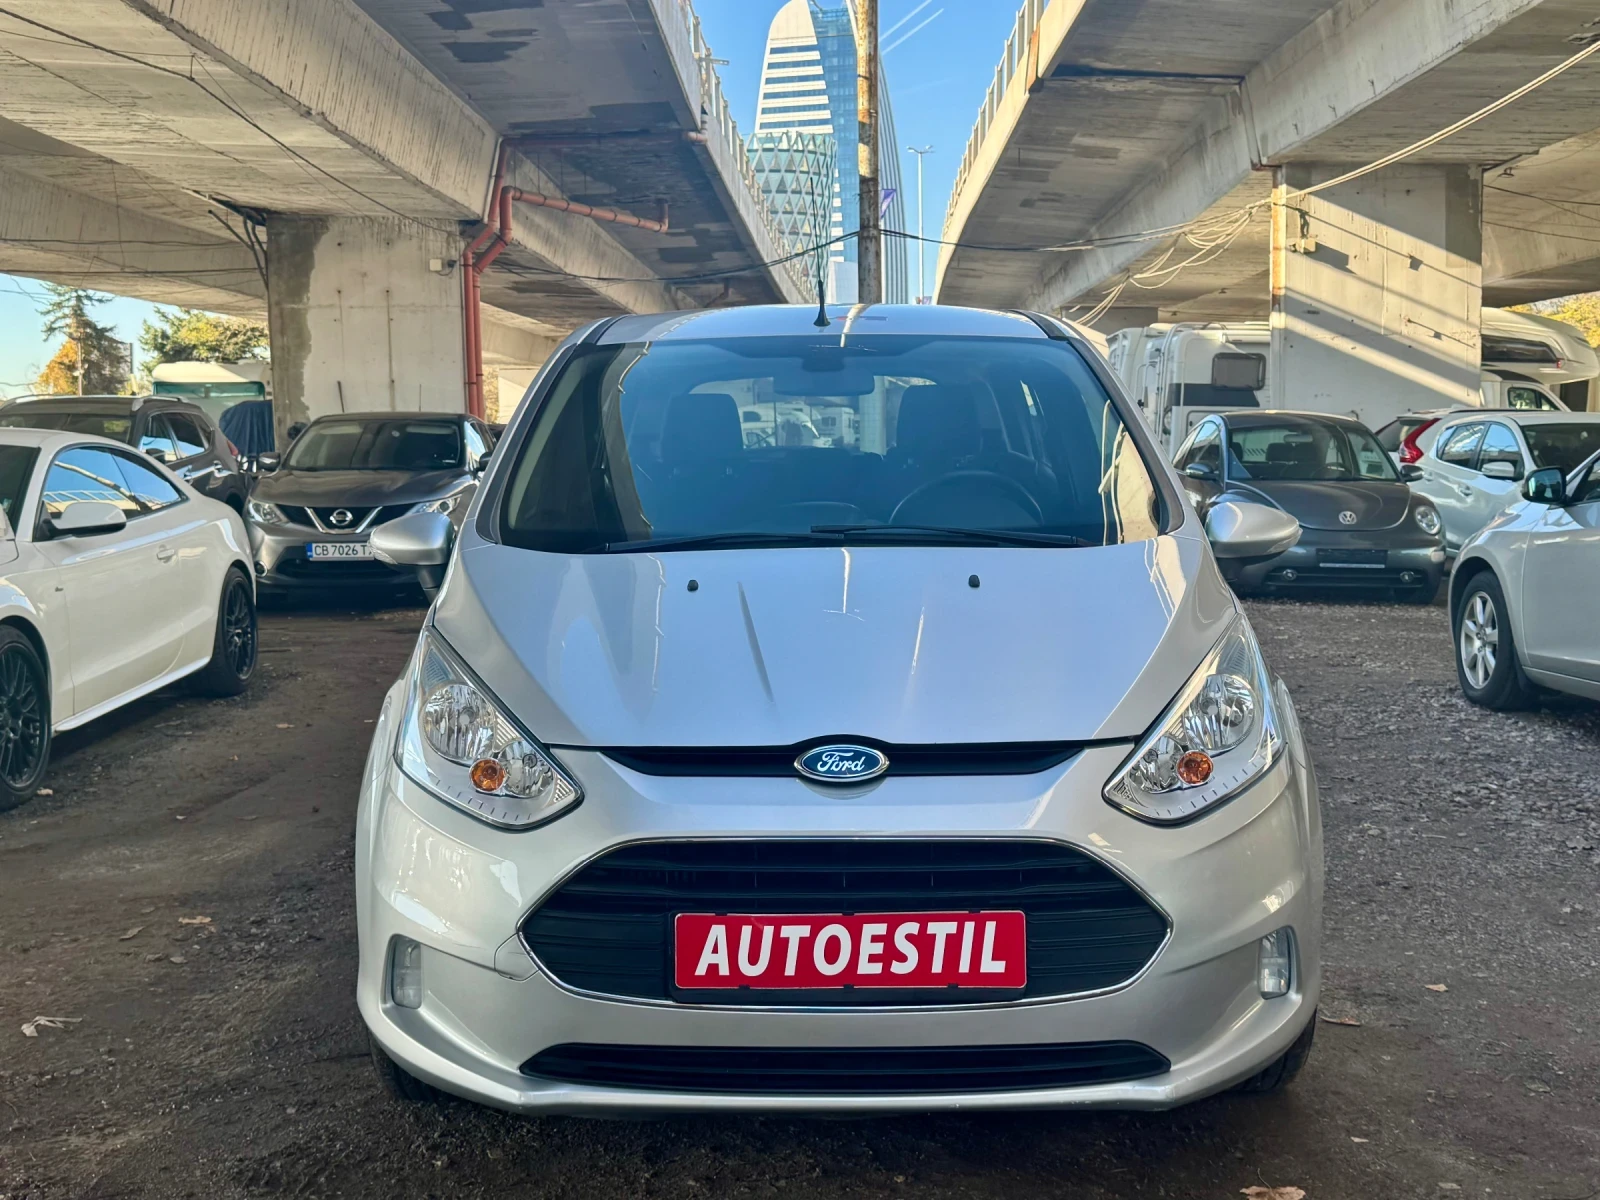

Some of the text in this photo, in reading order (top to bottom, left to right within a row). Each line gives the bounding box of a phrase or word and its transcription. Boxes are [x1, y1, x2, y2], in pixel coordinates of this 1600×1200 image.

[314, 545, 329, 556] CB
[331, 545, 358, 556] 7026
[817, 751, 866, 772] Ford
[694, 920, 1006, 976] AUTOESTIL
